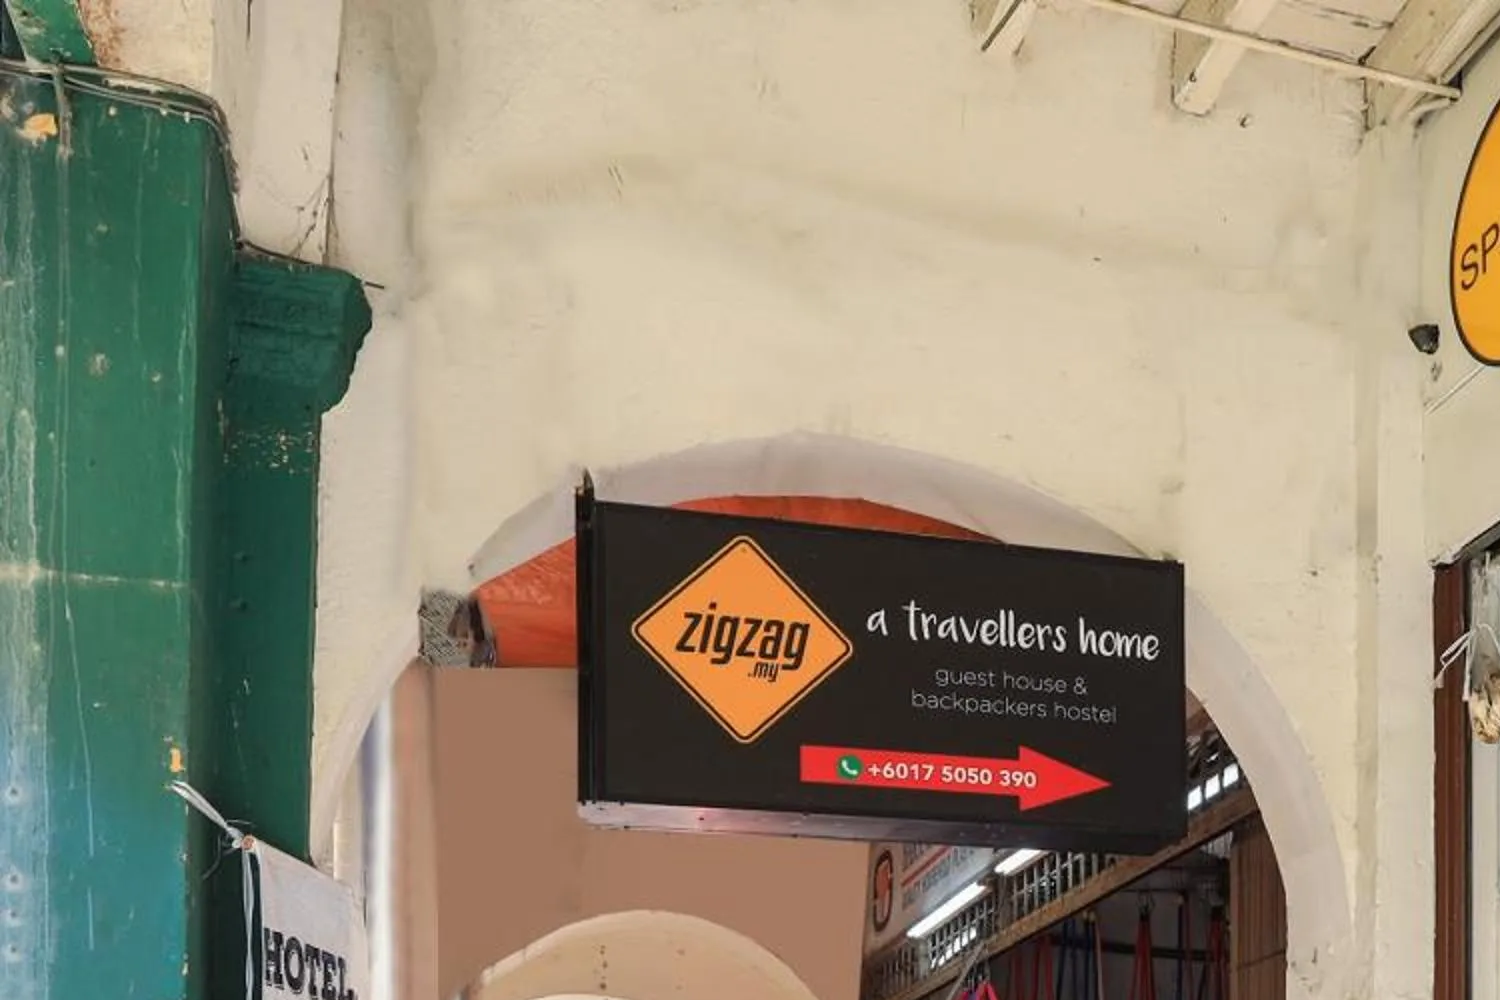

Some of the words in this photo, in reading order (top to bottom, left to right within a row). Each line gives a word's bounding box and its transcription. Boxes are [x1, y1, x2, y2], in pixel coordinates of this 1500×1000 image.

[675, 603, 811, 671] zigzag
[866, 609, 888, 637] a
[902, 600, 1067, 653] travellers
[1078, 616, 1160, 661] home
[935, 669, 997, 688] guest
[1003, 671, 1067, 694] house
[1073, 676, 1088, 695] &
[911, 688, 1048, 718] backpackers
[1053, 702, 1117, 725] hostel
[868, 761, 935, 781] +6017
[941, 767, 993, 786] 5050
[999, 770, 1037, 788] 390
